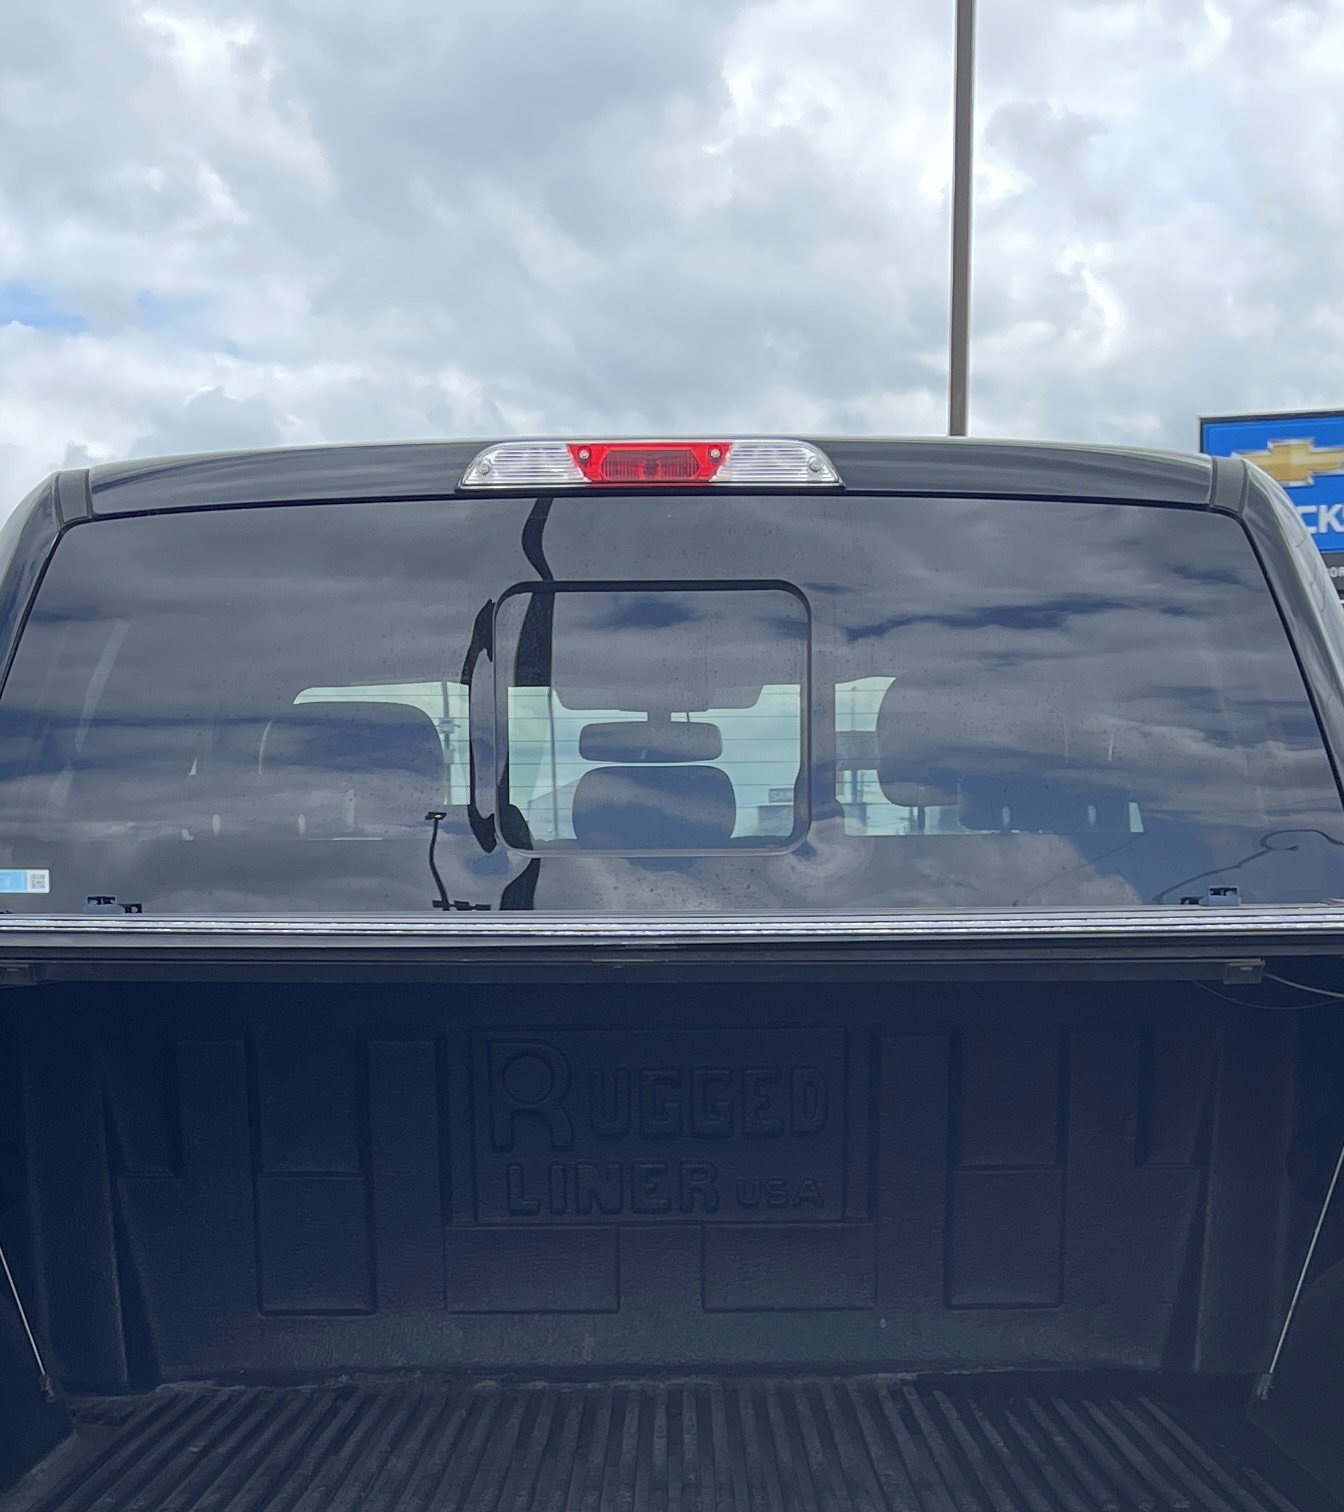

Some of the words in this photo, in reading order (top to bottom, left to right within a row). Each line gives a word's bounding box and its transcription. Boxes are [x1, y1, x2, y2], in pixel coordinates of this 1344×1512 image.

[487, 1038, 830, 1153] RUGGED
[506, 1159, 721, 1217] LINER
[735, 1176, 825, 1209] USA
